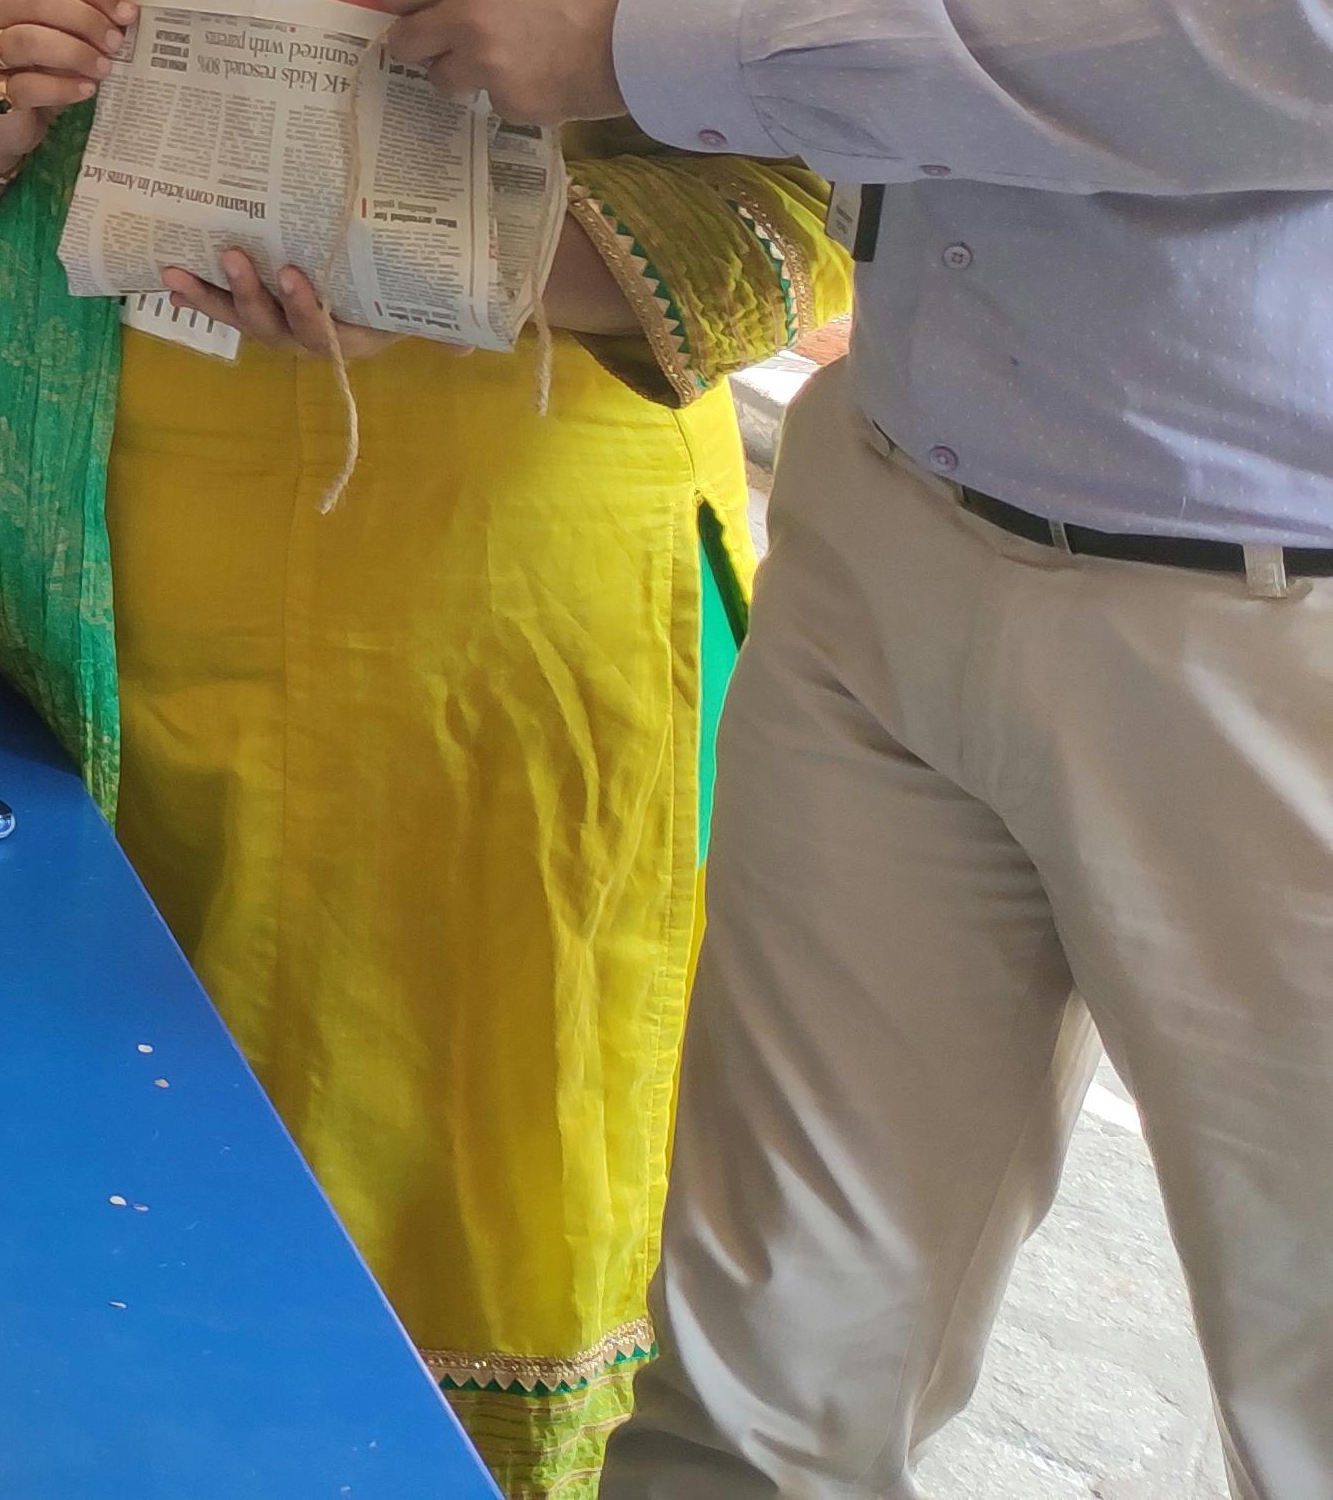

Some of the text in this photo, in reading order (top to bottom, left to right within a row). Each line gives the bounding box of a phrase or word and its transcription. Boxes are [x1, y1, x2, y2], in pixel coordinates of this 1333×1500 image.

[249, 36, 284, 57] with
[282, 68, 317, 92] kids
[83, 164, 104, 181] Act
[138, 177, 149, 196] in
[153, 178, 215, 206] convicted
[217, 194, 266, 219] Bhanu
